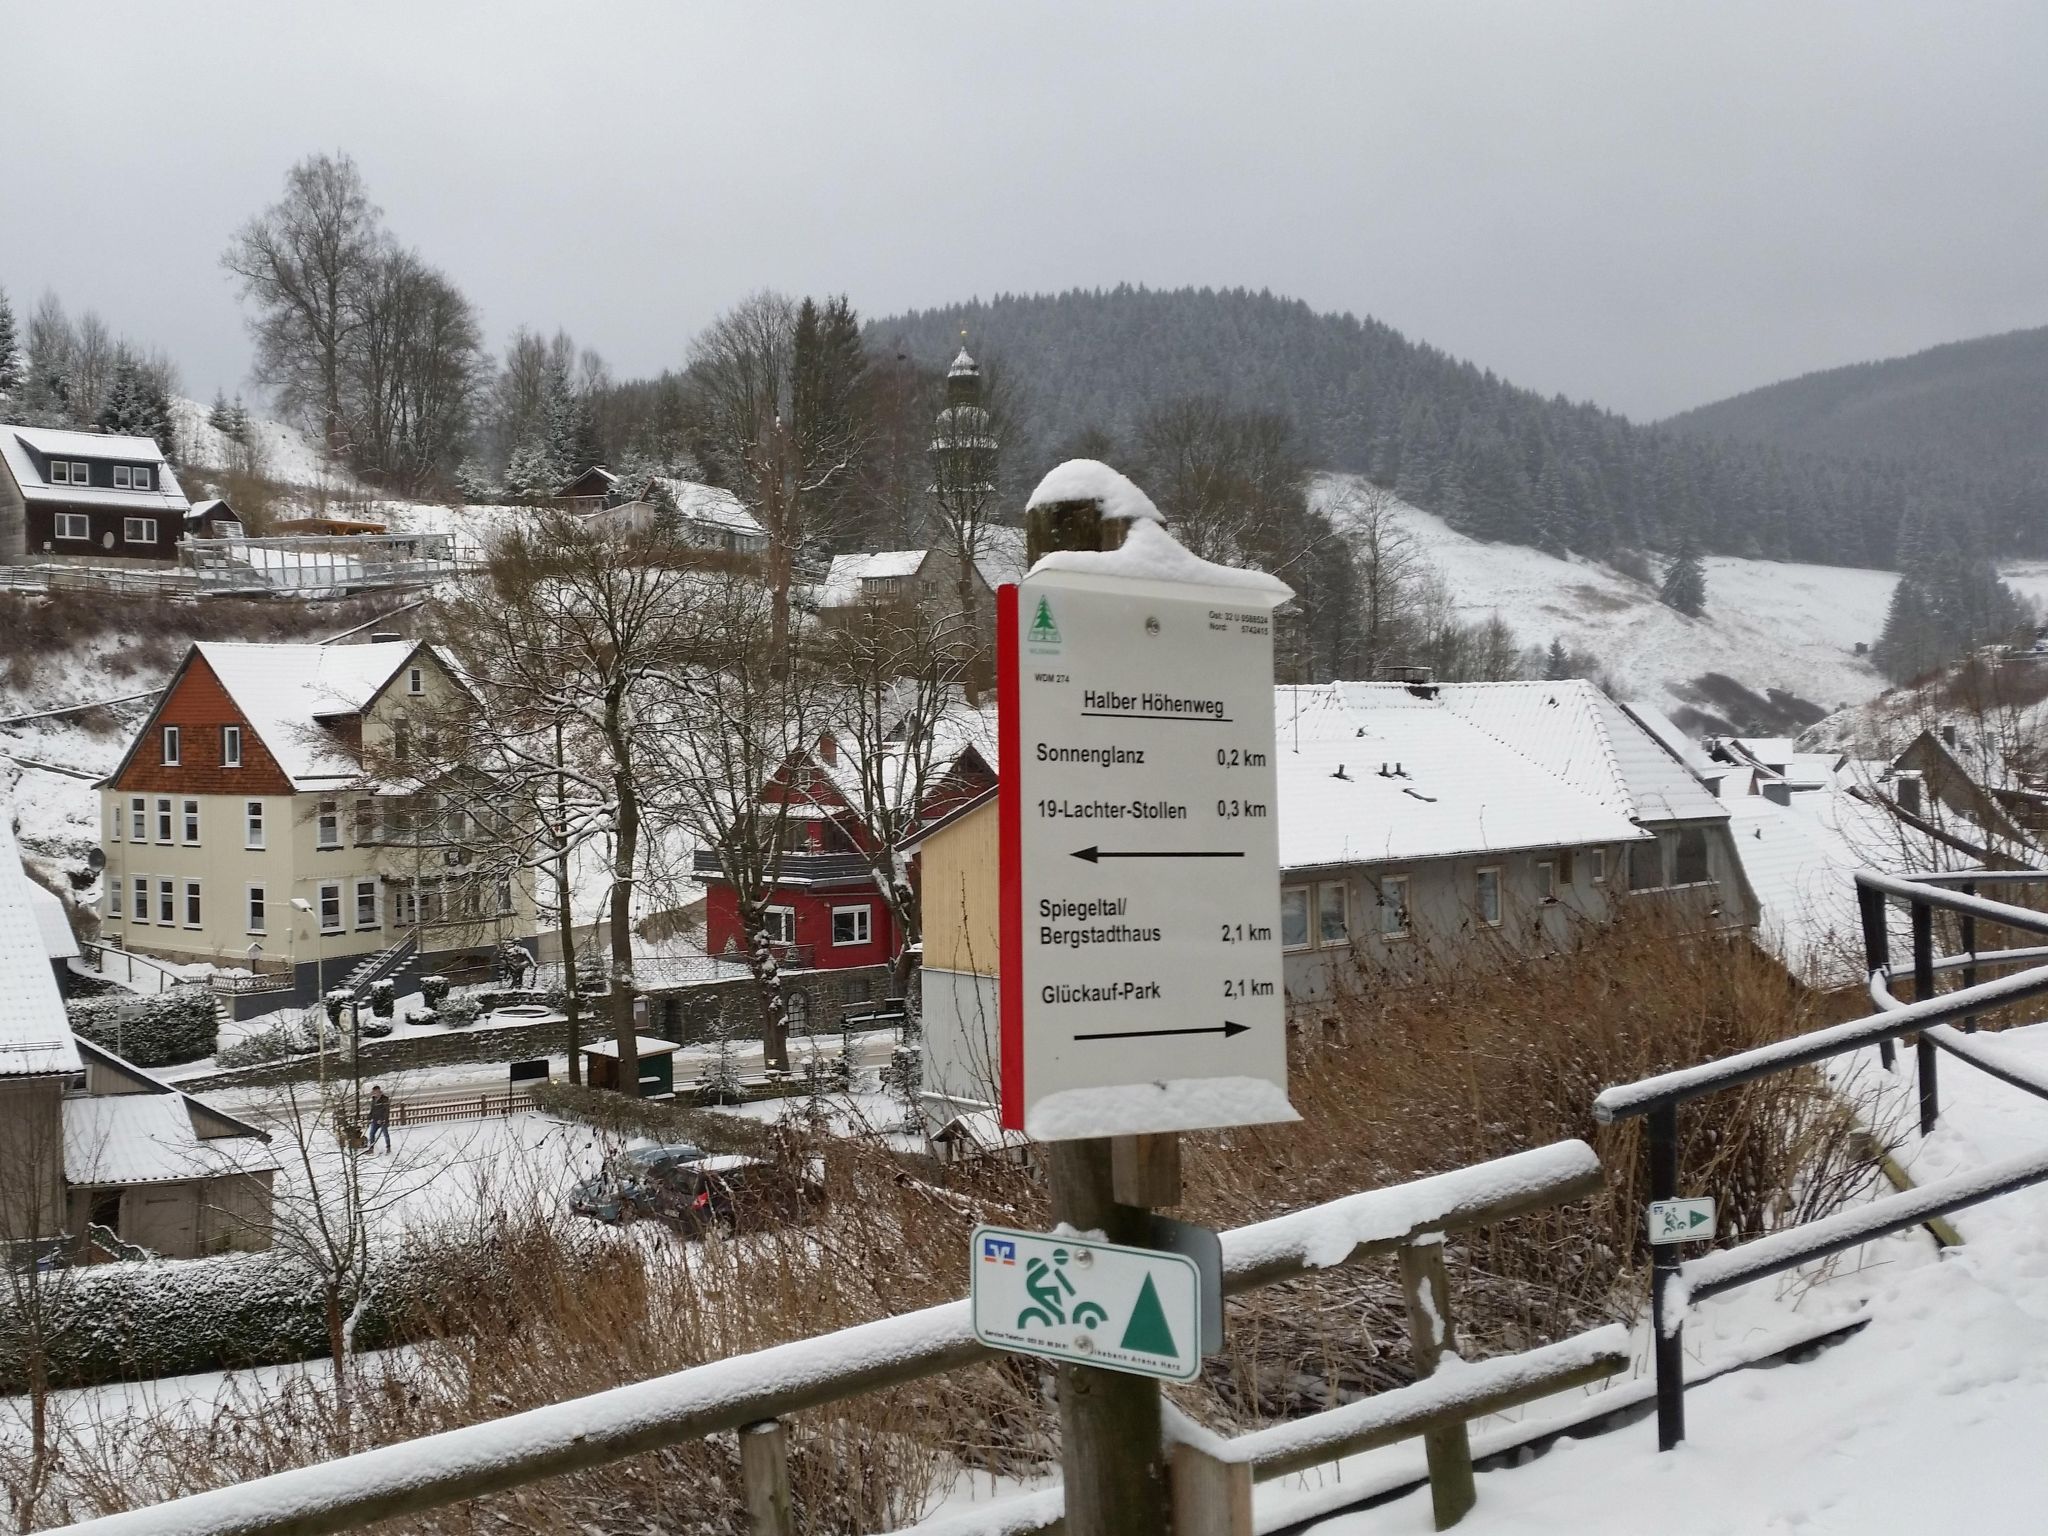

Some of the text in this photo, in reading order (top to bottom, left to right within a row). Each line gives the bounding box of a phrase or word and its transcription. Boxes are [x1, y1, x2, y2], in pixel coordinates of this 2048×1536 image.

[1034, 673, 1070, 683] WDM 274
[1084, 690, 1224, 718] Halber Höhenweg
[1037, 743, 1266, 768] Sonnenglanz 0,2 km
[1038, 800, 1267, 820] 19-Lachter-Stollen 0,3 km
[1040, 898, 1127, 921] Spiegeltal/
[1040, 924, 1272, 948] Bergstadthaus 2,1 km
[1042, 979, 1274, 1004] Glückauf-Park 2,1 km
